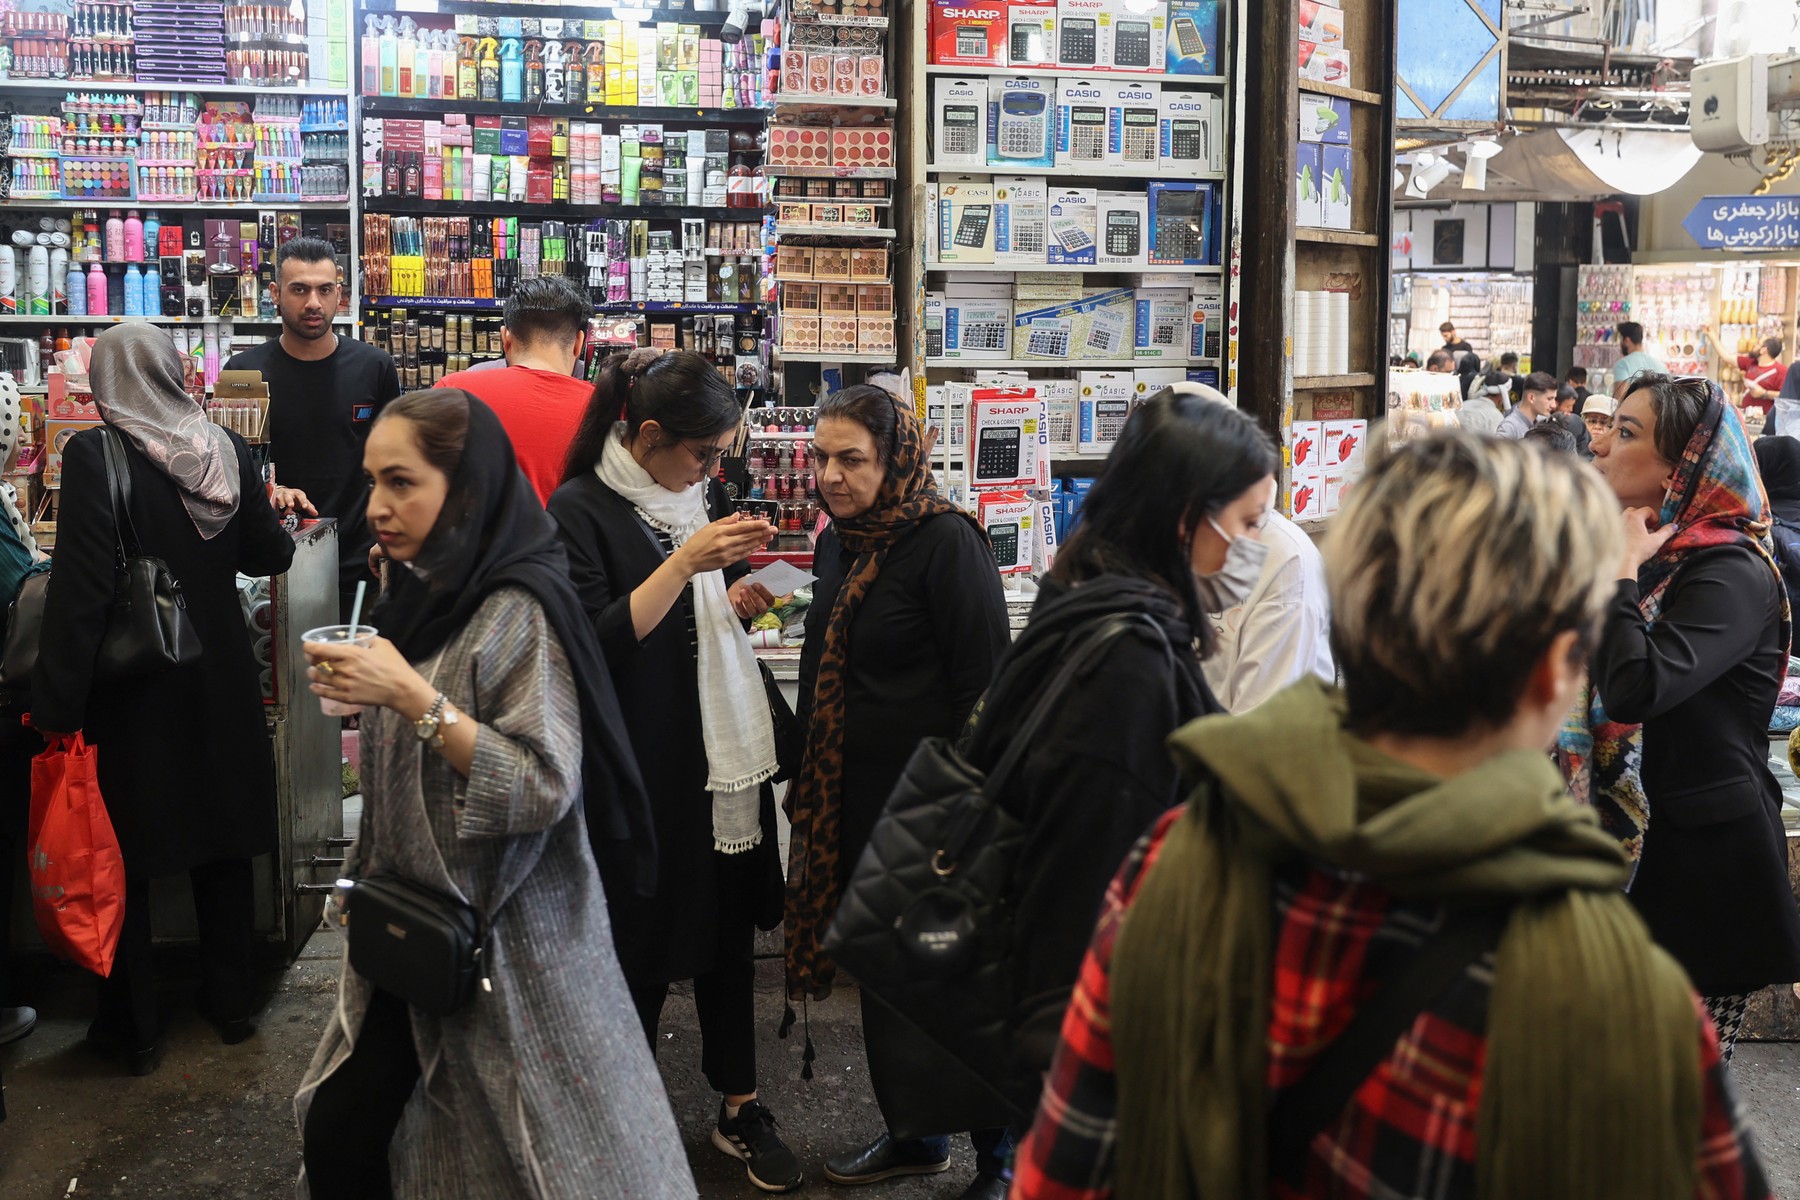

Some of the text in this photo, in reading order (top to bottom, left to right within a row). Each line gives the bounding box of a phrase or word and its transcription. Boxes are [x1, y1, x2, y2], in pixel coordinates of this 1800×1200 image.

[943, 8, 1000, 19] SHARP
[1066, 90, 1100, 98] CASIO
[1713, 201, 1799, 222] بازار جعفری
[1763, 224, 1799, 245] بازار
[1042, 506, 1053, 545] CASIO
